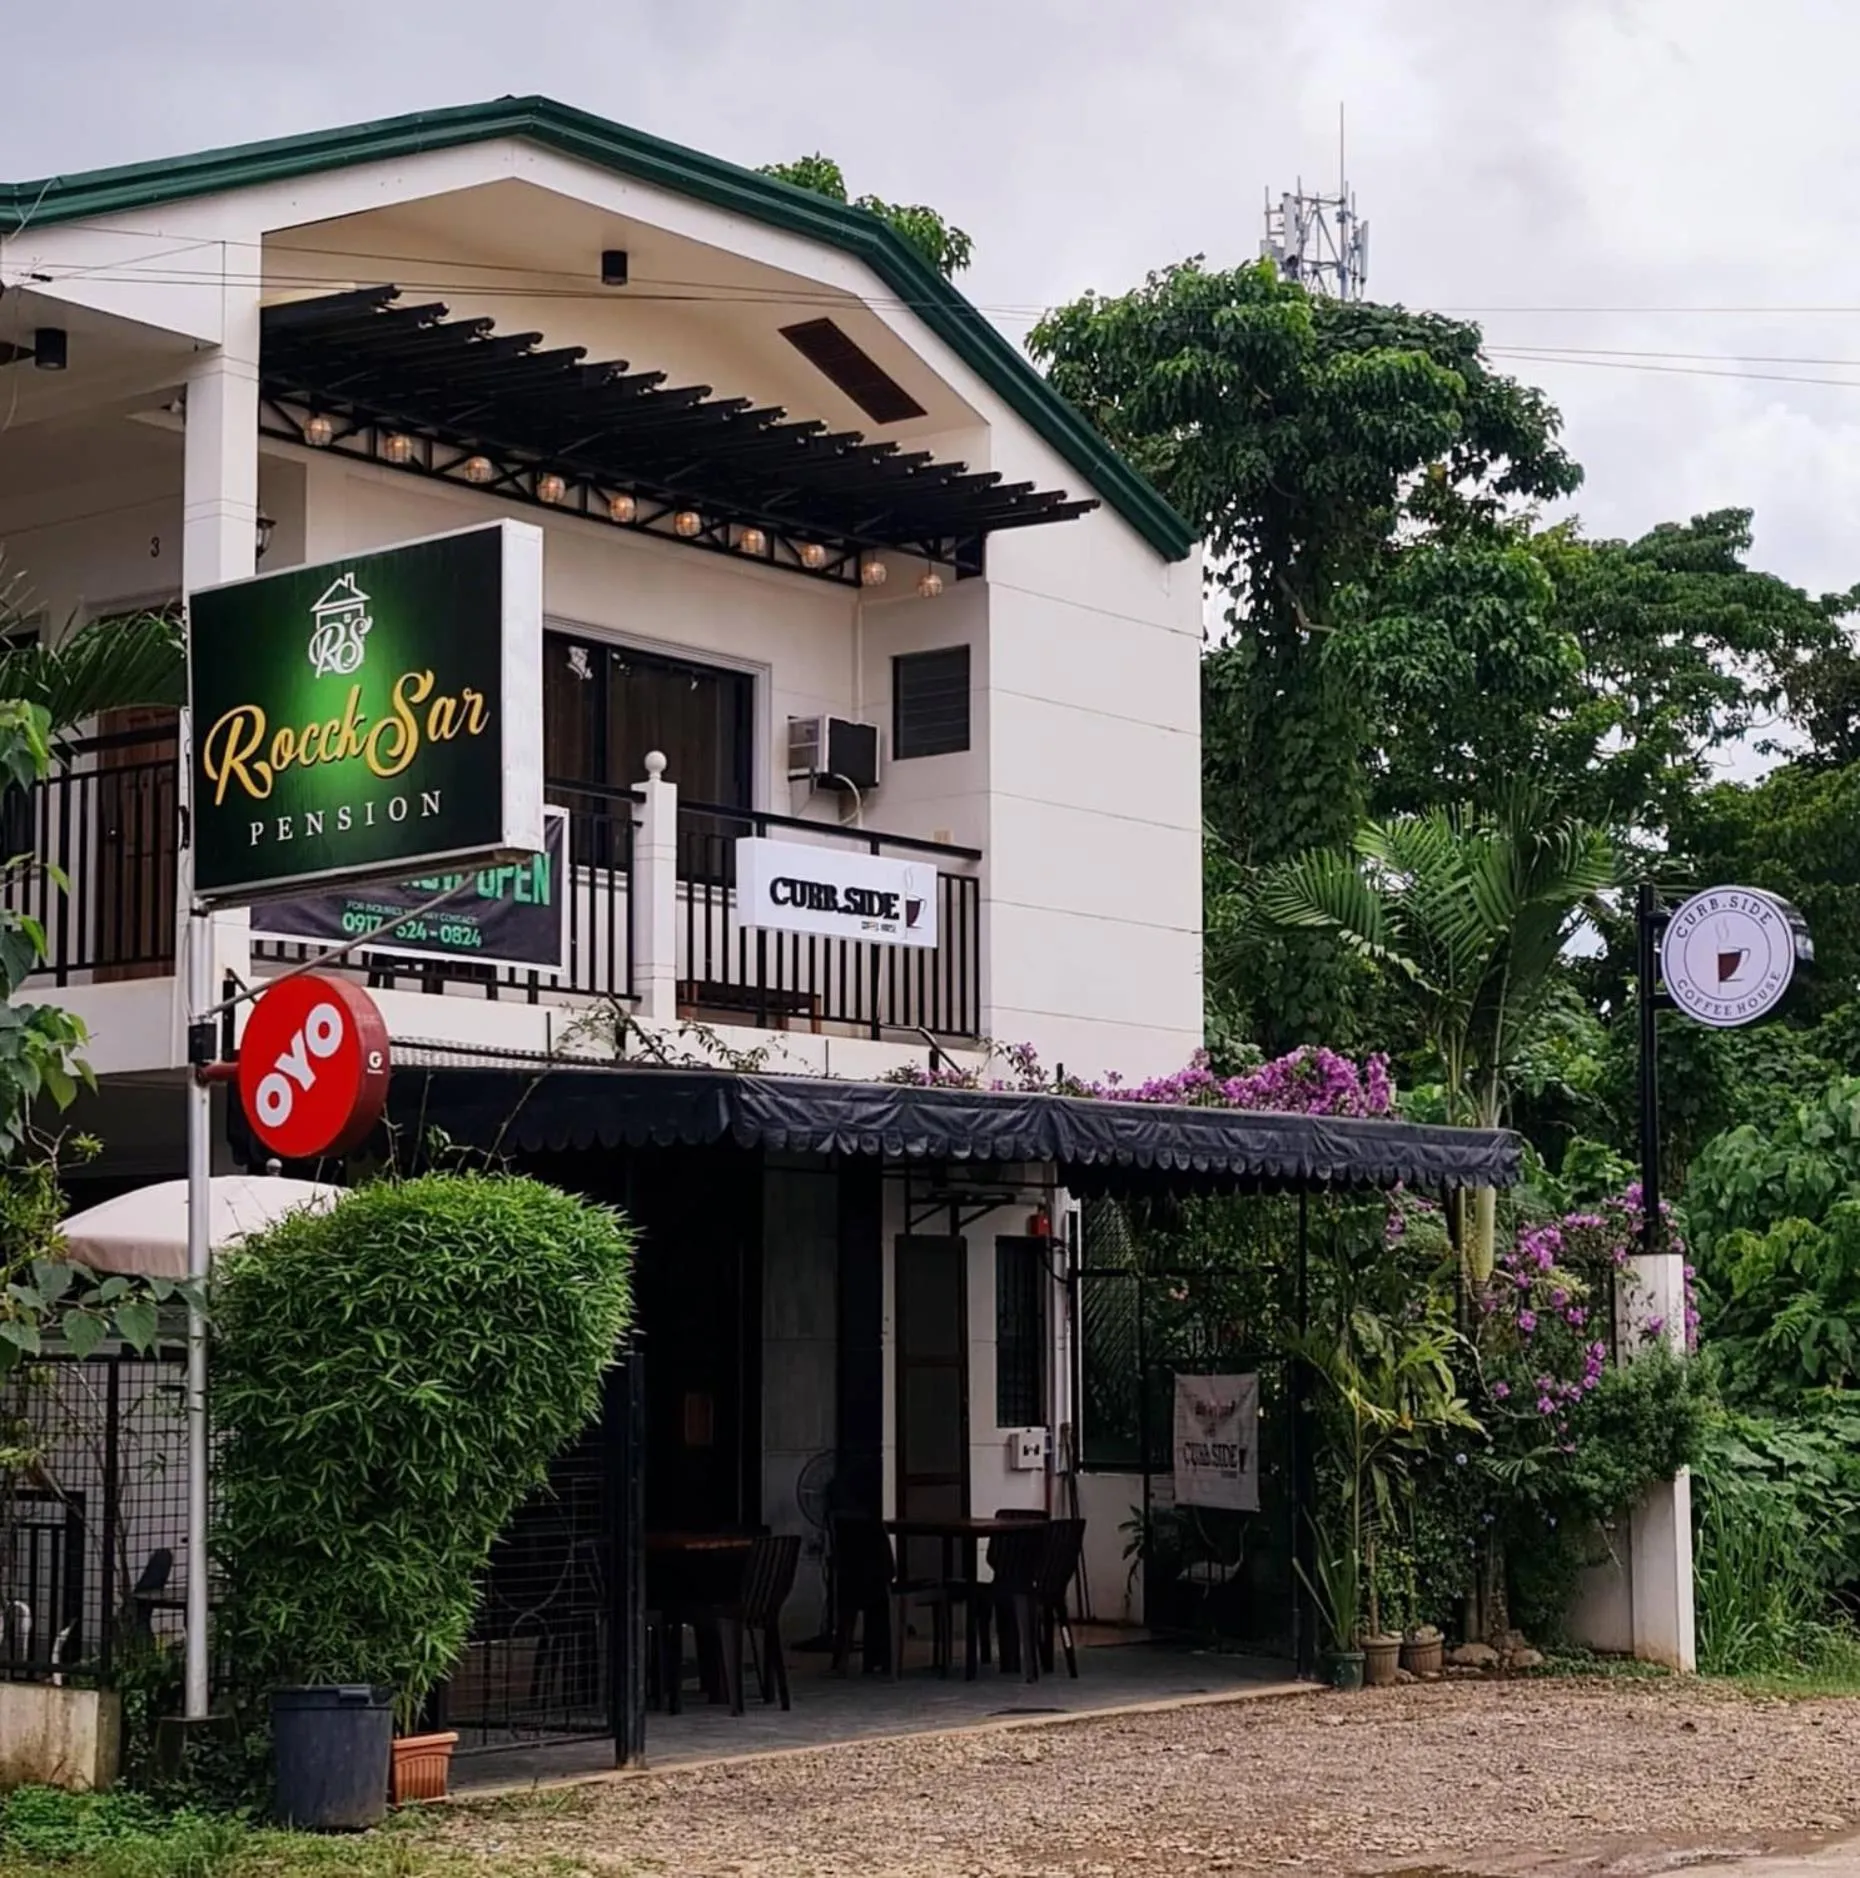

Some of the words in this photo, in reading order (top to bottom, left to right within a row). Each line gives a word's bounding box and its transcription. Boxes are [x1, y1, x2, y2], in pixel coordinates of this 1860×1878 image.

[151, 536, 160, 558] 3
[308, 615, 373, 679] RS
[250, 791, 442, 845] PENSION
[1676, 896, 1773, 939] CURB.SIDE
[1677, 979, 1732, 1016] COFFEE
[1736, 971, 1781, 1013] HOUSE
[255, 1003, 344, 1128] OYO
